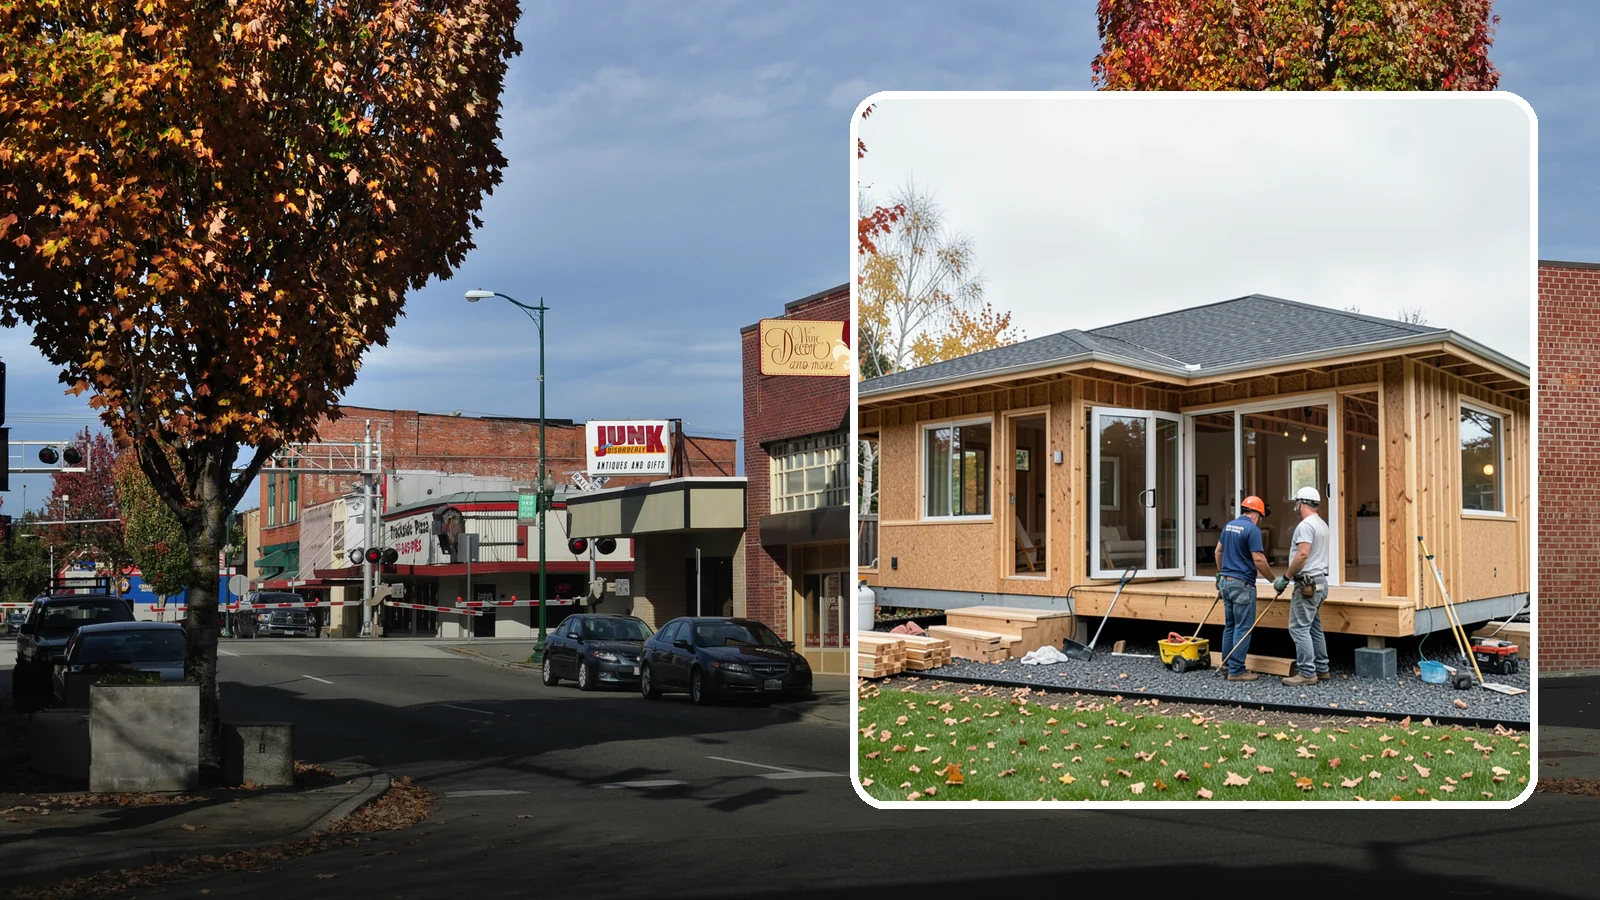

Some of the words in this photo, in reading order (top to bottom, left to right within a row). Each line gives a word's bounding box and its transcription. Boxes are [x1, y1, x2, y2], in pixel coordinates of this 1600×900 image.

[765, 327, 830, 365] Decor
[595, 425, 665, 457] JUNK
[607, 446, 646, 454] DISORDERLY
[597, 461, 628, 470] ANTIQUES
[631, 460, 643, 469] AND
[647, 460, 665, 469] GIFTS
[573, 473, 588, 491] RAIL
[590, 476, 608, 491] SING
[352, 498, 364, 511] CRO
[390, 521, 413, 539] Trackside
[414, 519, 429, 535] Pizza
